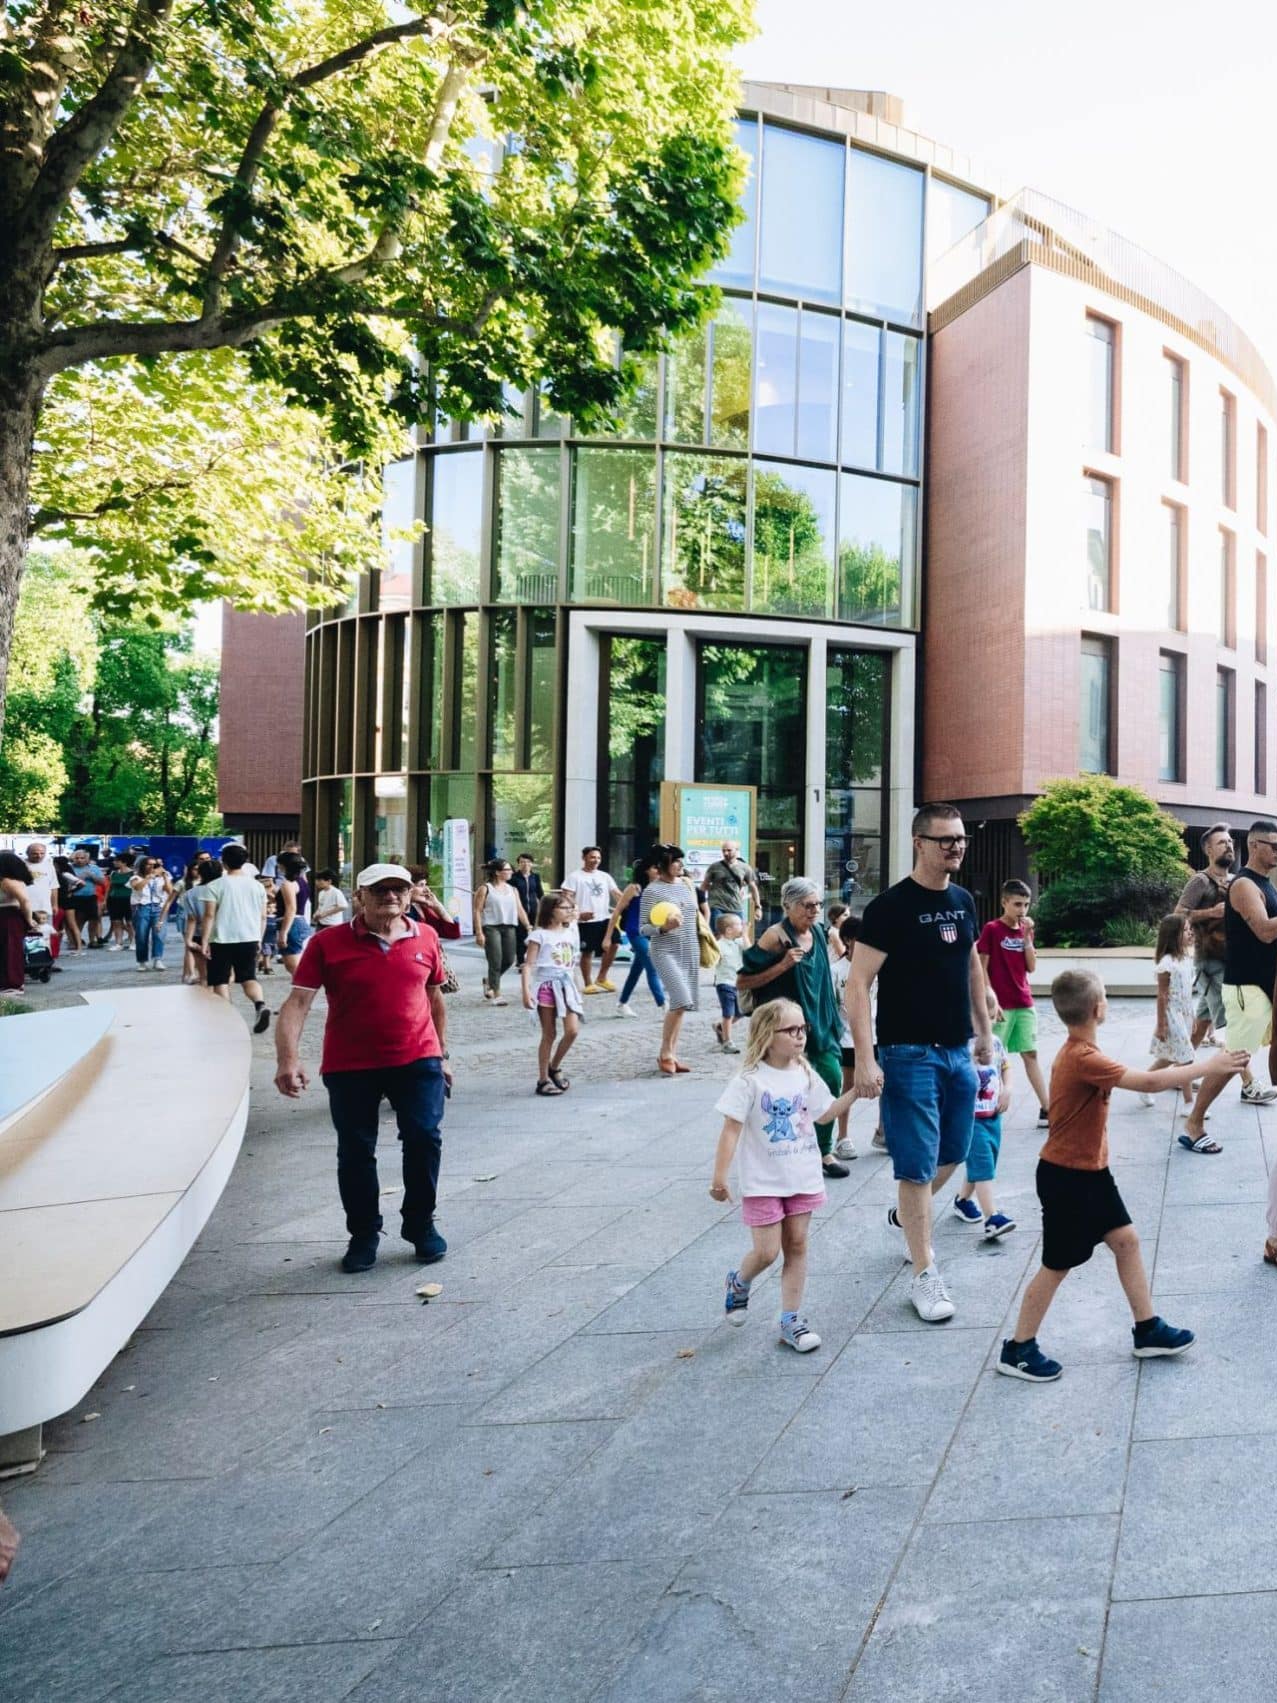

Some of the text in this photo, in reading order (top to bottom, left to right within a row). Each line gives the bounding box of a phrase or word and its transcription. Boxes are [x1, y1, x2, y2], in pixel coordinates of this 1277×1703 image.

[813, 789, 820, 803] 1
[687, 816, 726, 826] EVENTI
[687, 825, 738, 835] PER TUTTI
[919, 910, 966, 924] GANT
